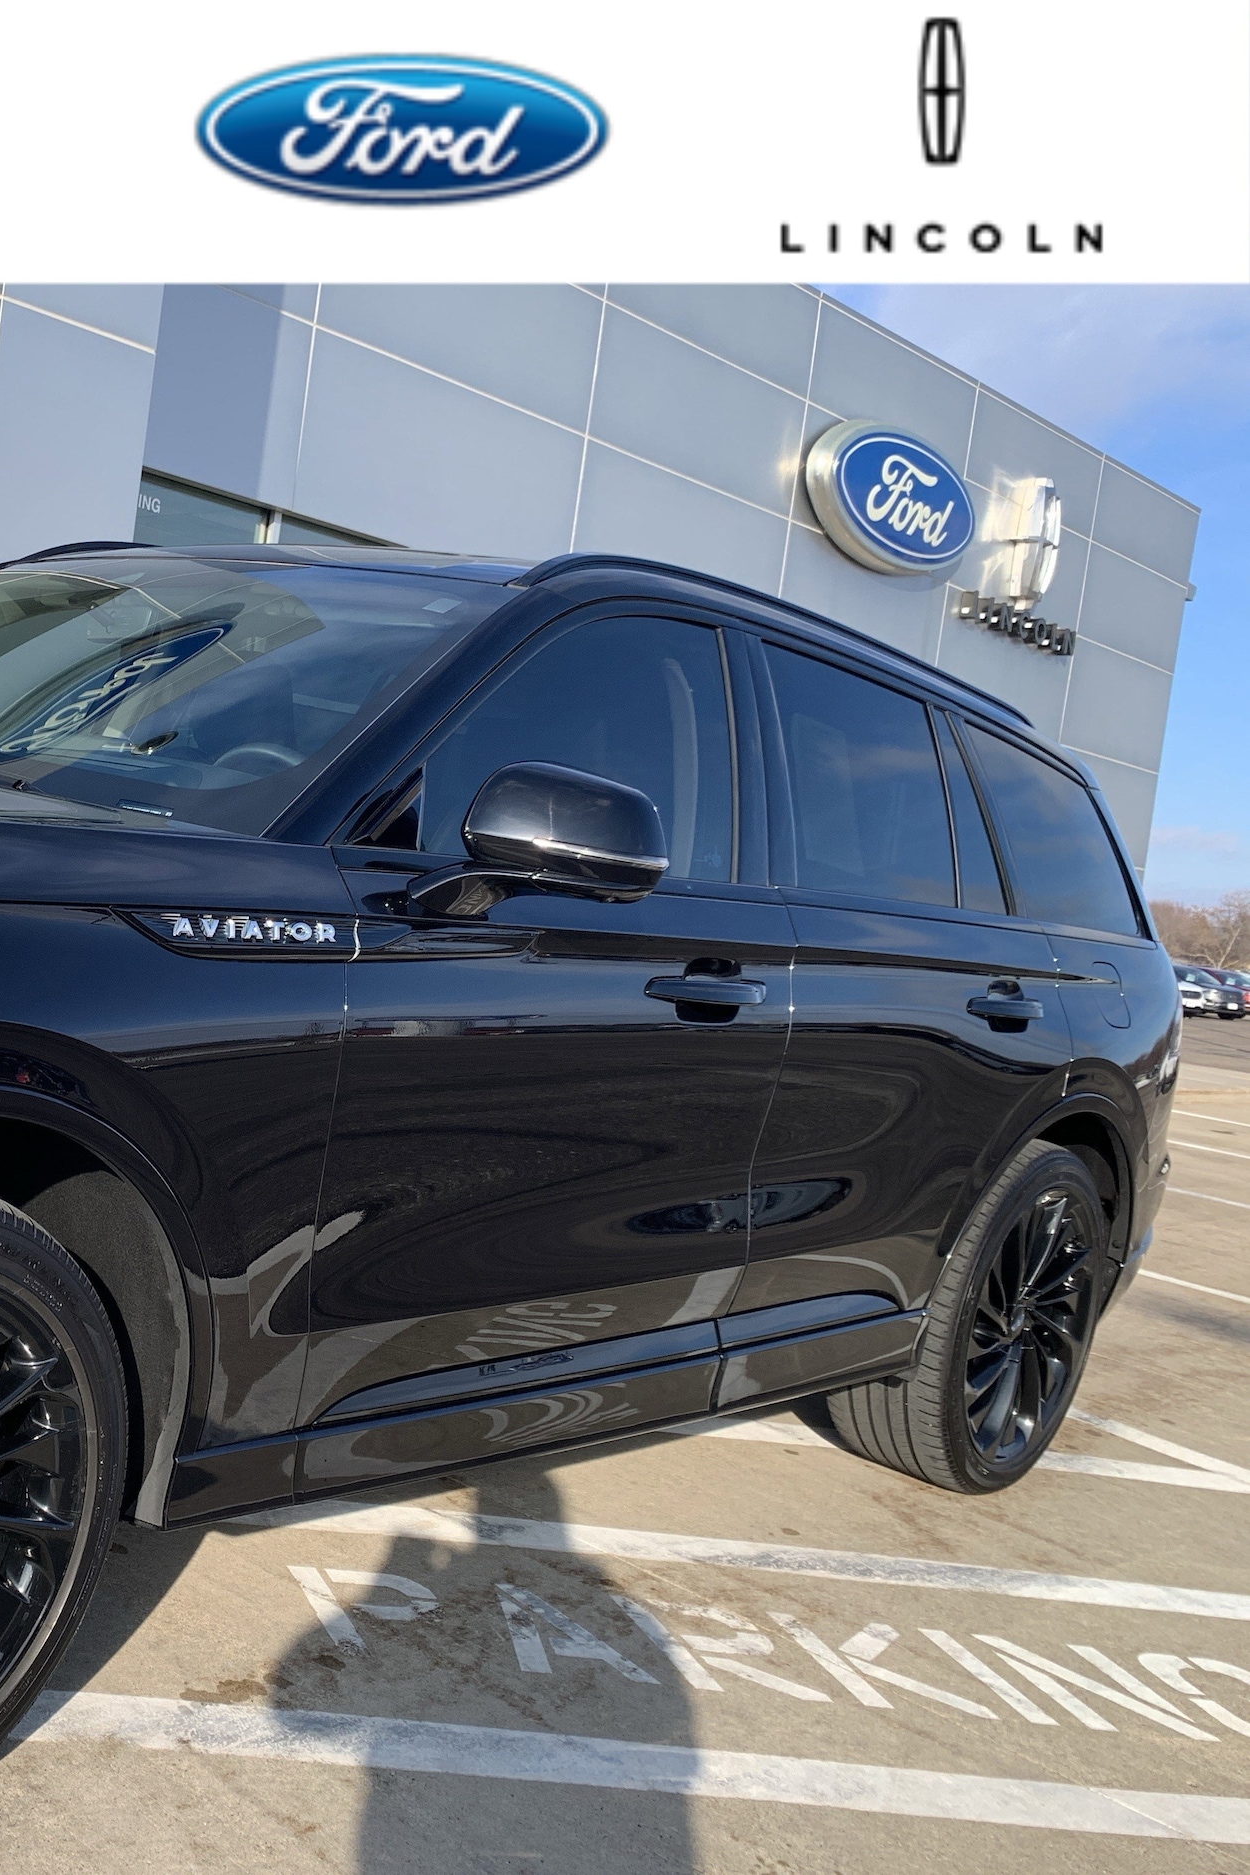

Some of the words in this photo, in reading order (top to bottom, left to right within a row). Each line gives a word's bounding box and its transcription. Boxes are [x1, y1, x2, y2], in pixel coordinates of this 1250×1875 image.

[866, 455, 954, 547] Ford
[960, 590, 1076, 656] LINCOLN
[171, 916, 336, 943] AVIATOR
